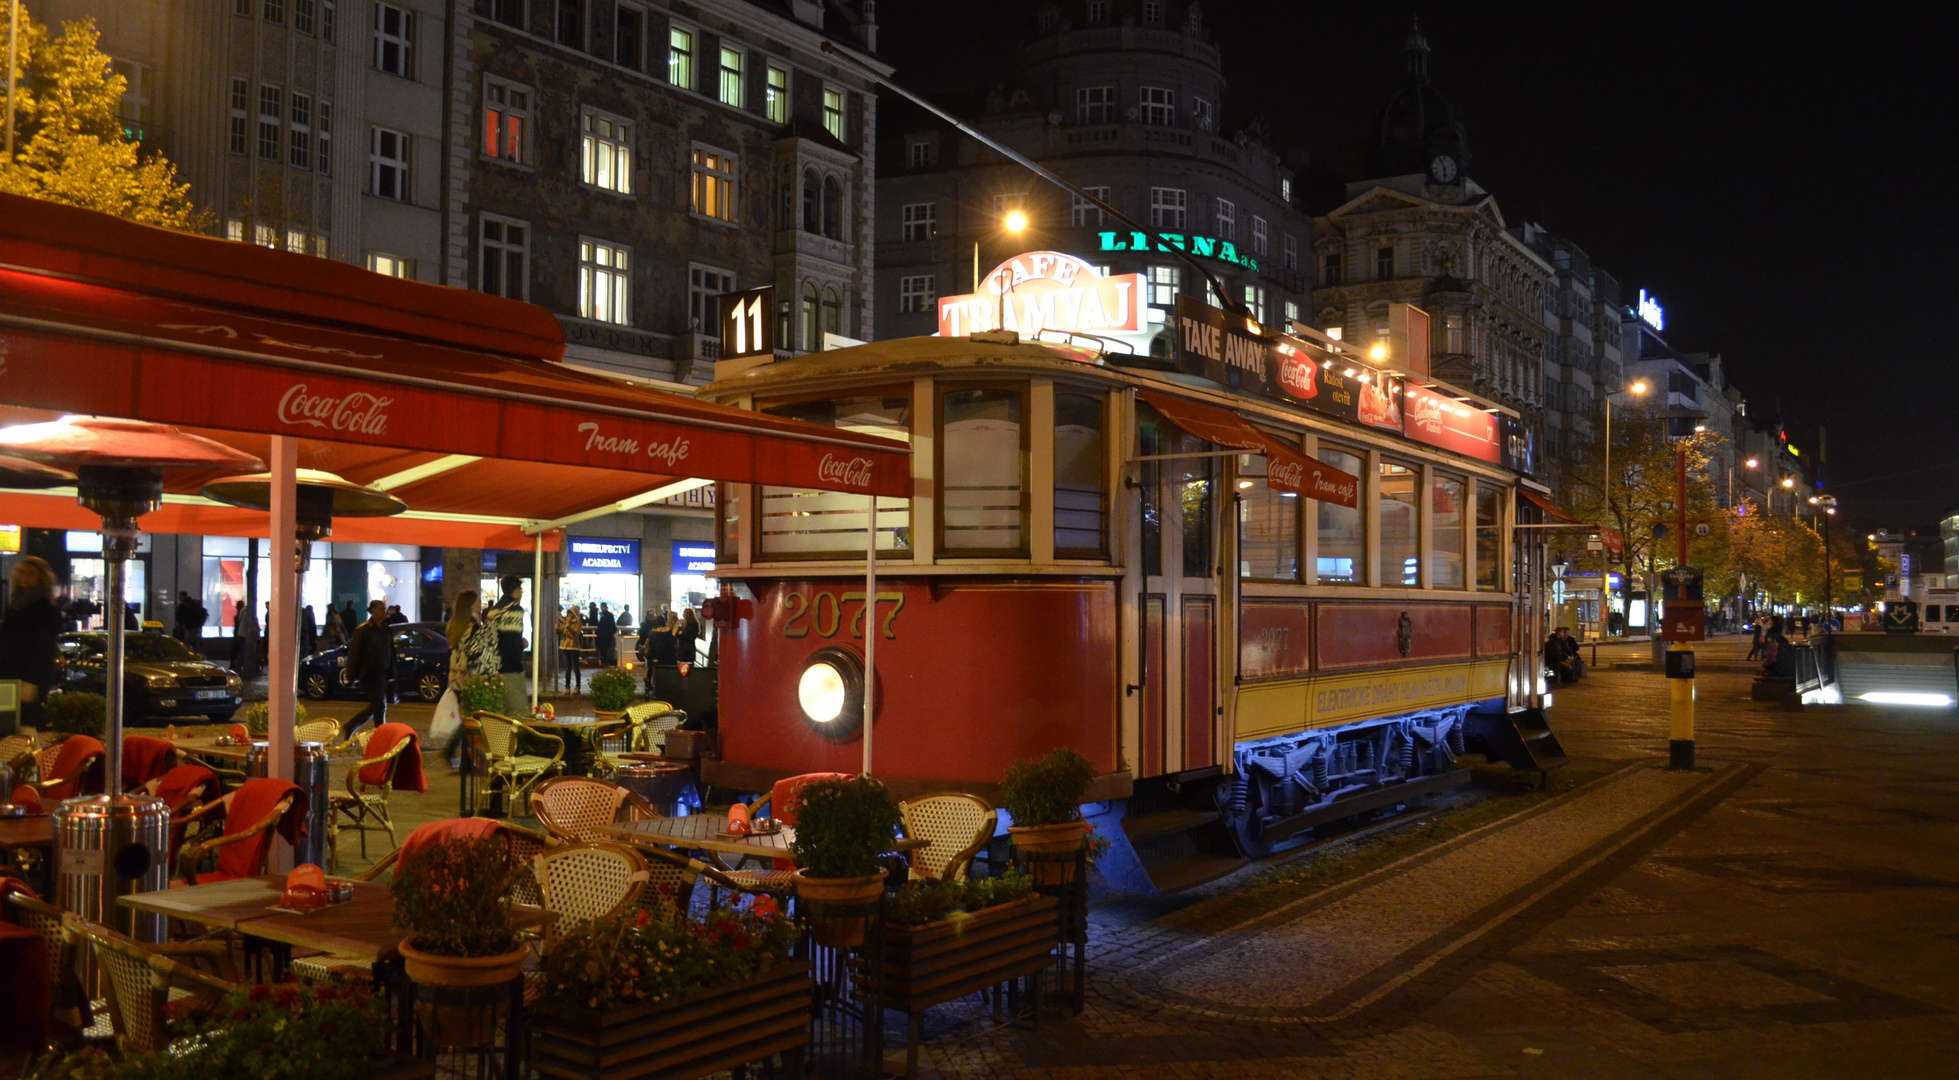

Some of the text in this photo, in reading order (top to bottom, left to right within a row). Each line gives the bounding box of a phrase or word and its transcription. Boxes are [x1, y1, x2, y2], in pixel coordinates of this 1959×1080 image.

[1098, 231, 1239, 264] LIGNA
[987, 253, 1081, 297] CAFE
[731, 294, 762, 354] 11
[942, 282, 1133, 338] TRAMVAJ
[1182, 317, 1221, 362] TAKE
[1281, 358, 1312, 391] Coca-Cola
[1324, 369, 1343, 389] Radost
[277, 384, 394, 435] Coca-Cola
[578, 422, 690, 467] Tram café
[818, 452, 875, 487] Coca-Cola
[1268, 458, 1303, 488] Coca-Cola
[1313, 470, 1337, 493] Tram
[582, 558, 622, 568] ACADEMIA
[783, 591, 906, 640] 2077
[1260, 627, 1290, 652] 2077
[1317, 680, 1371, 713] ELEKTRICKÉ
